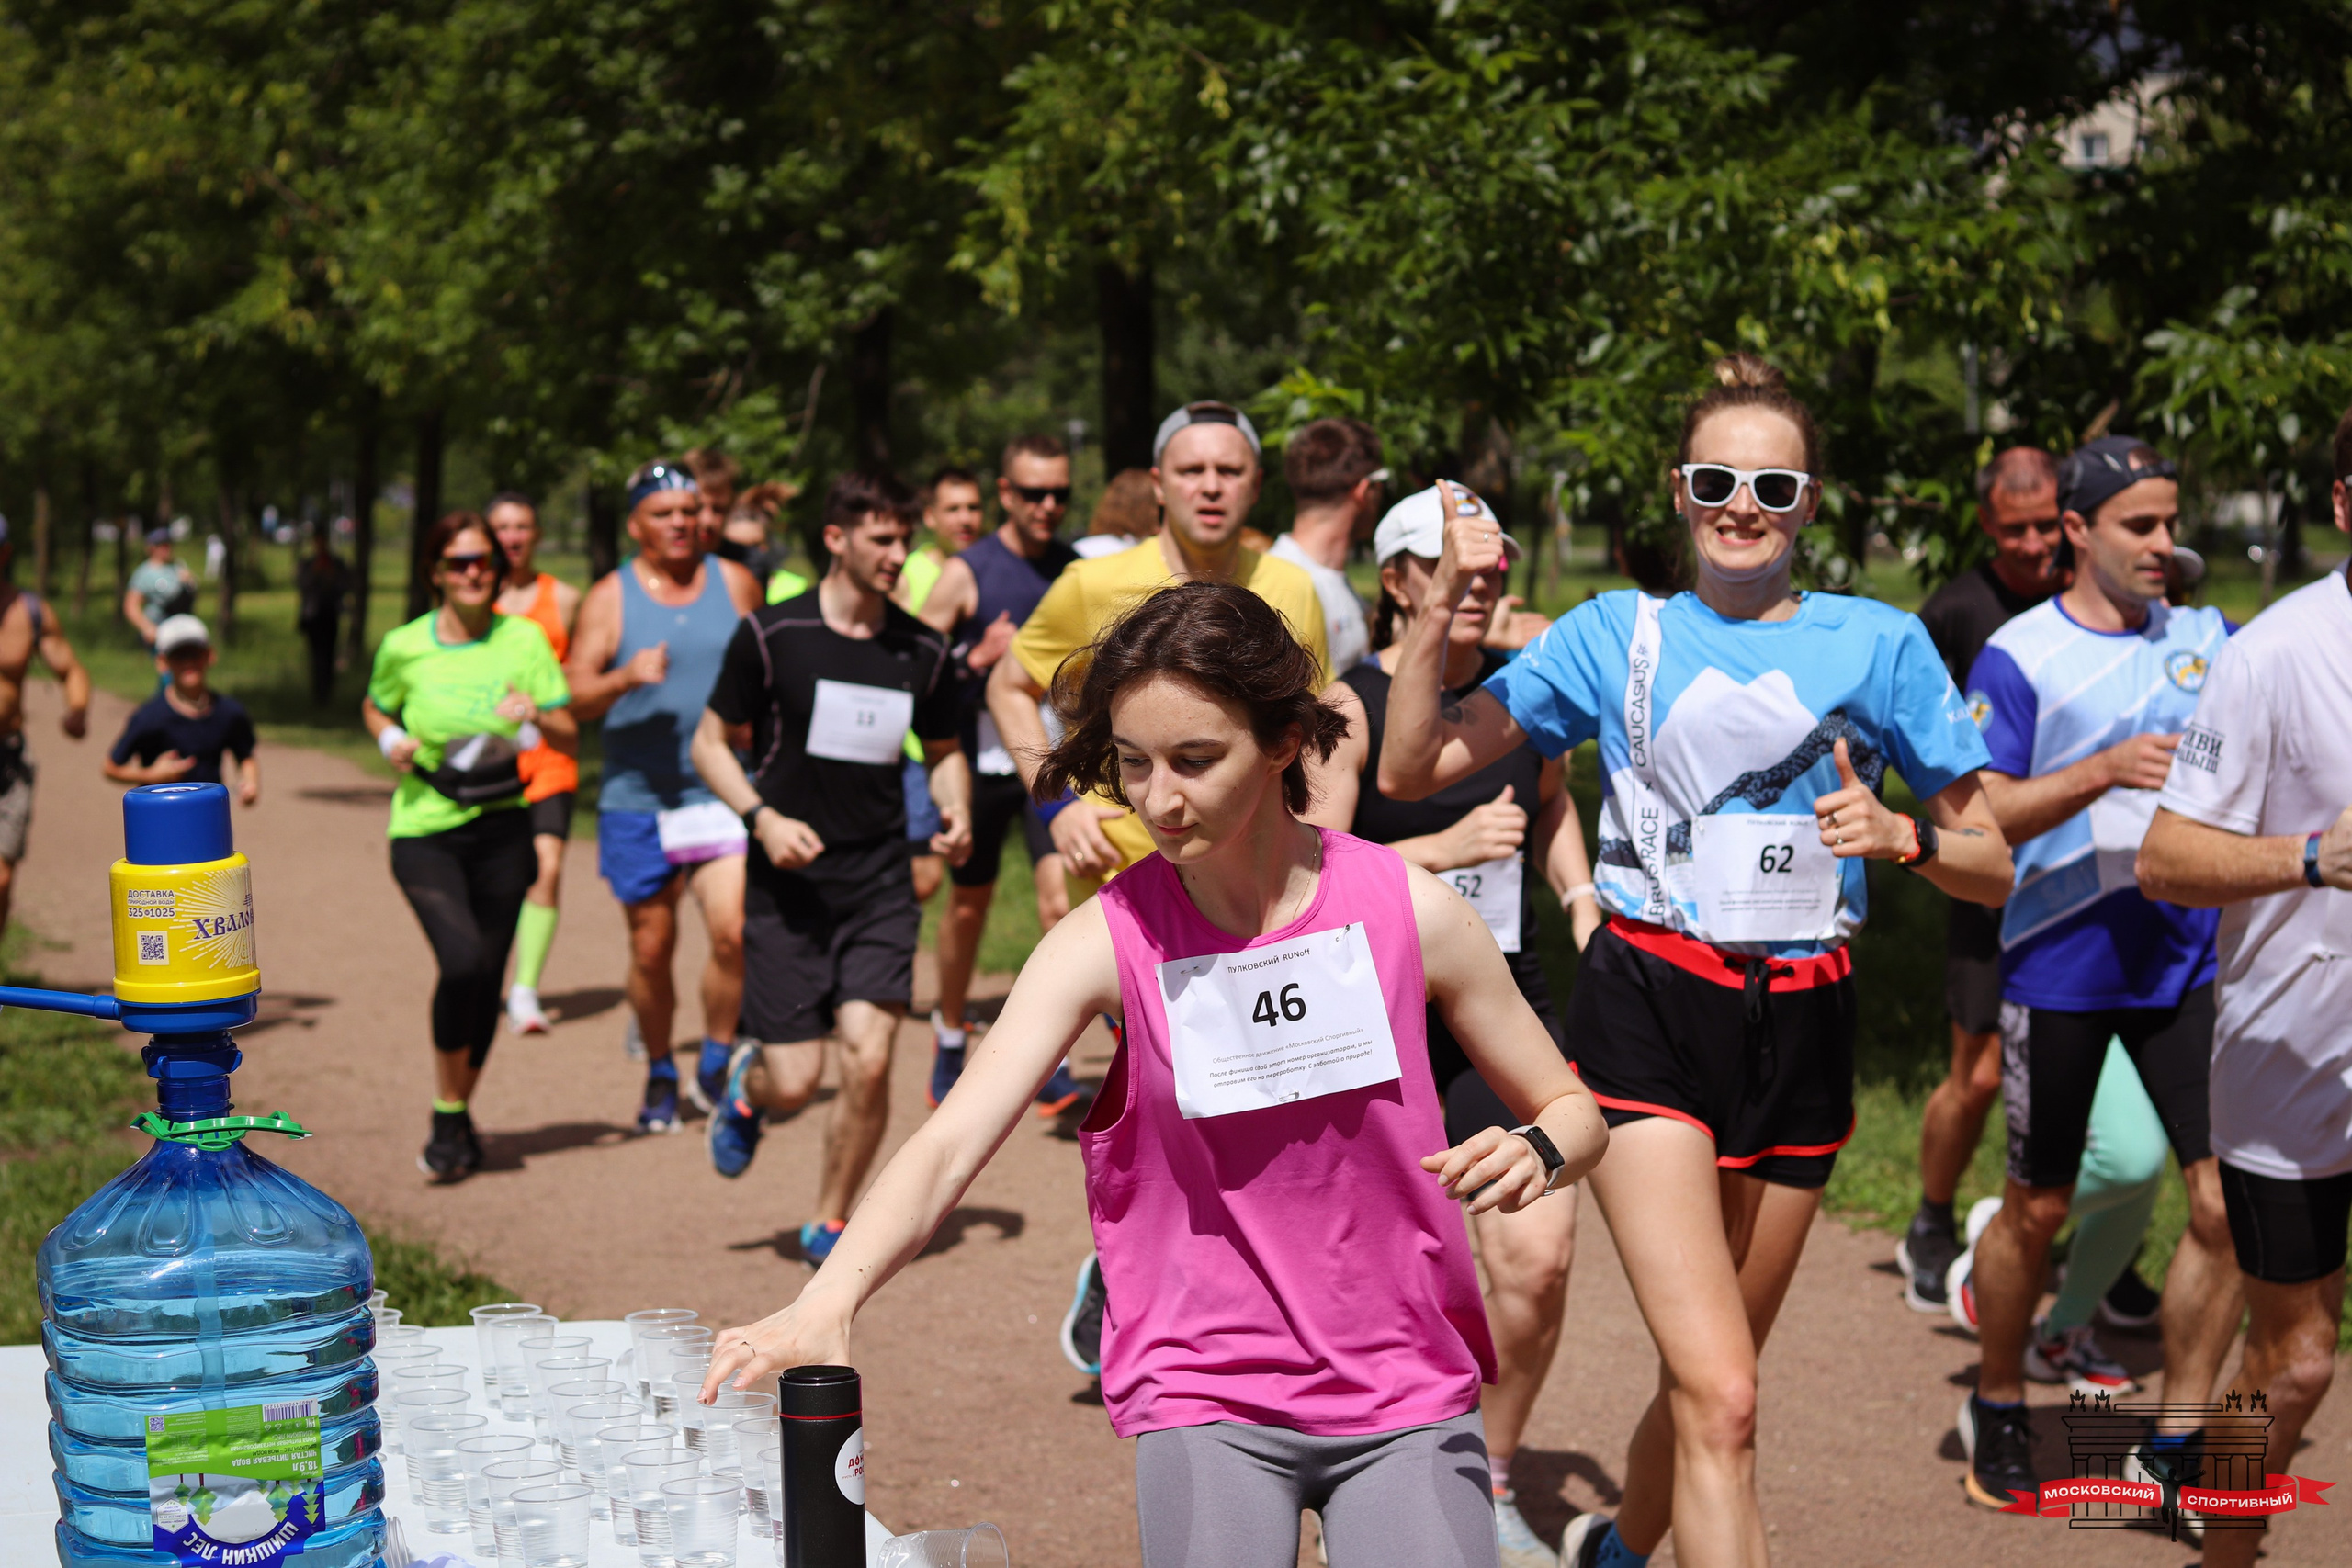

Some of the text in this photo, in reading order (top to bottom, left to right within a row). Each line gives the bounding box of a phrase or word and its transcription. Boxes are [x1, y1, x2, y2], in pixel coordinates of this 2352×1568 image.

[1631, 658, 1649, 767] CAUCASUS
[1641, 807, 1658, 861] RACE
[1759, 844, 1794, 874] 62
[128, 890, 175, 898] ДОСТАВКА
[1455, 875, 1482, 897] 52
[1227, 948, 1310, 974] ПУЛКОВСКИЙ RUNoff
[1252, 983, 1306, 1027] 46
[1213, 1028, 1363, 1064] Общественное движение «Московский Спортивный»
[1214, 1077, 1246, 1088] отправим
[1265, 1065, 1307, 1079] переработку.
[1313, 1056, 1340, 1068] заботой
[1346, 1049, 1373, 1061] природе!
[1228, 1066, 1253, 1076] финиша
[1269, 1059, 1286, 1068] этот
[1287, 1055, 1306, 1063] номер
[277, 1438, 302, 1447] питьевая
[232, 1450, 317, 1467] ЧИСТАЯ ПИТЬЕВАЯ ВОДА
[300, 1461, 318, 1472] 18,9
[183, 1521, 300, 1565] ШИШКИН ЛЕС
